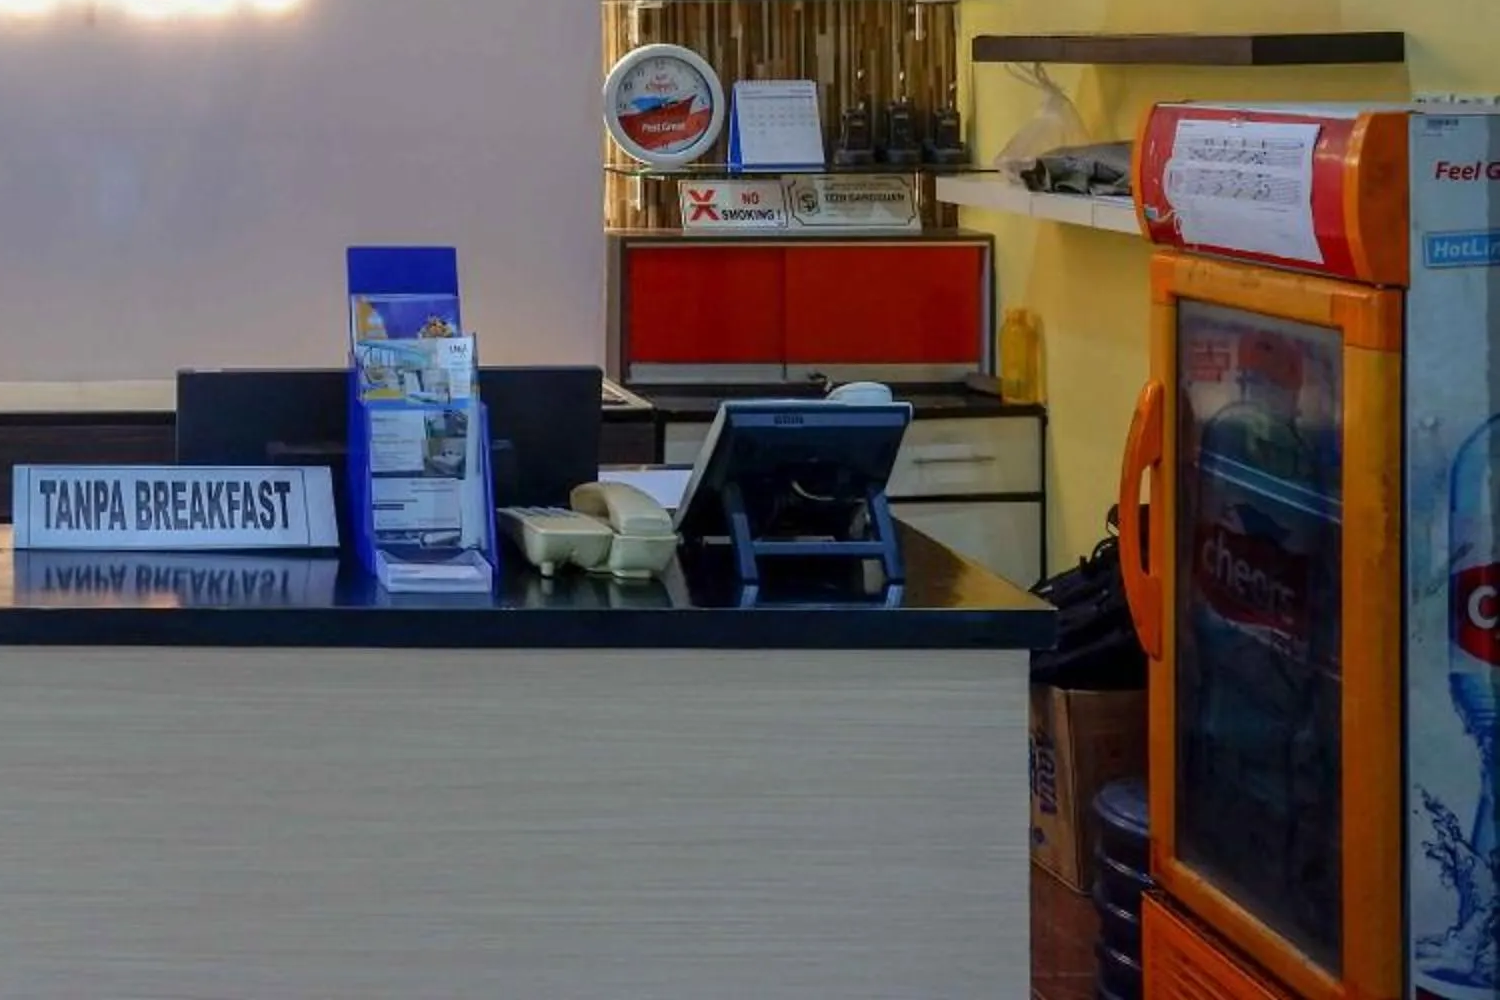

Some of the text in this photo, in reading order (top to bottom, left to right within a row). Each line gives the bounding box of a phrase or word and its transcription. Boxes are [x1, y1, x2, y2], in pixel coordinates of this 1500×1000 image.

[1435, 161, 1482, 181] Feel
[741, 191, 760, 205] NO
[39, 479, 291, 531] TANPA BREAKFAST
